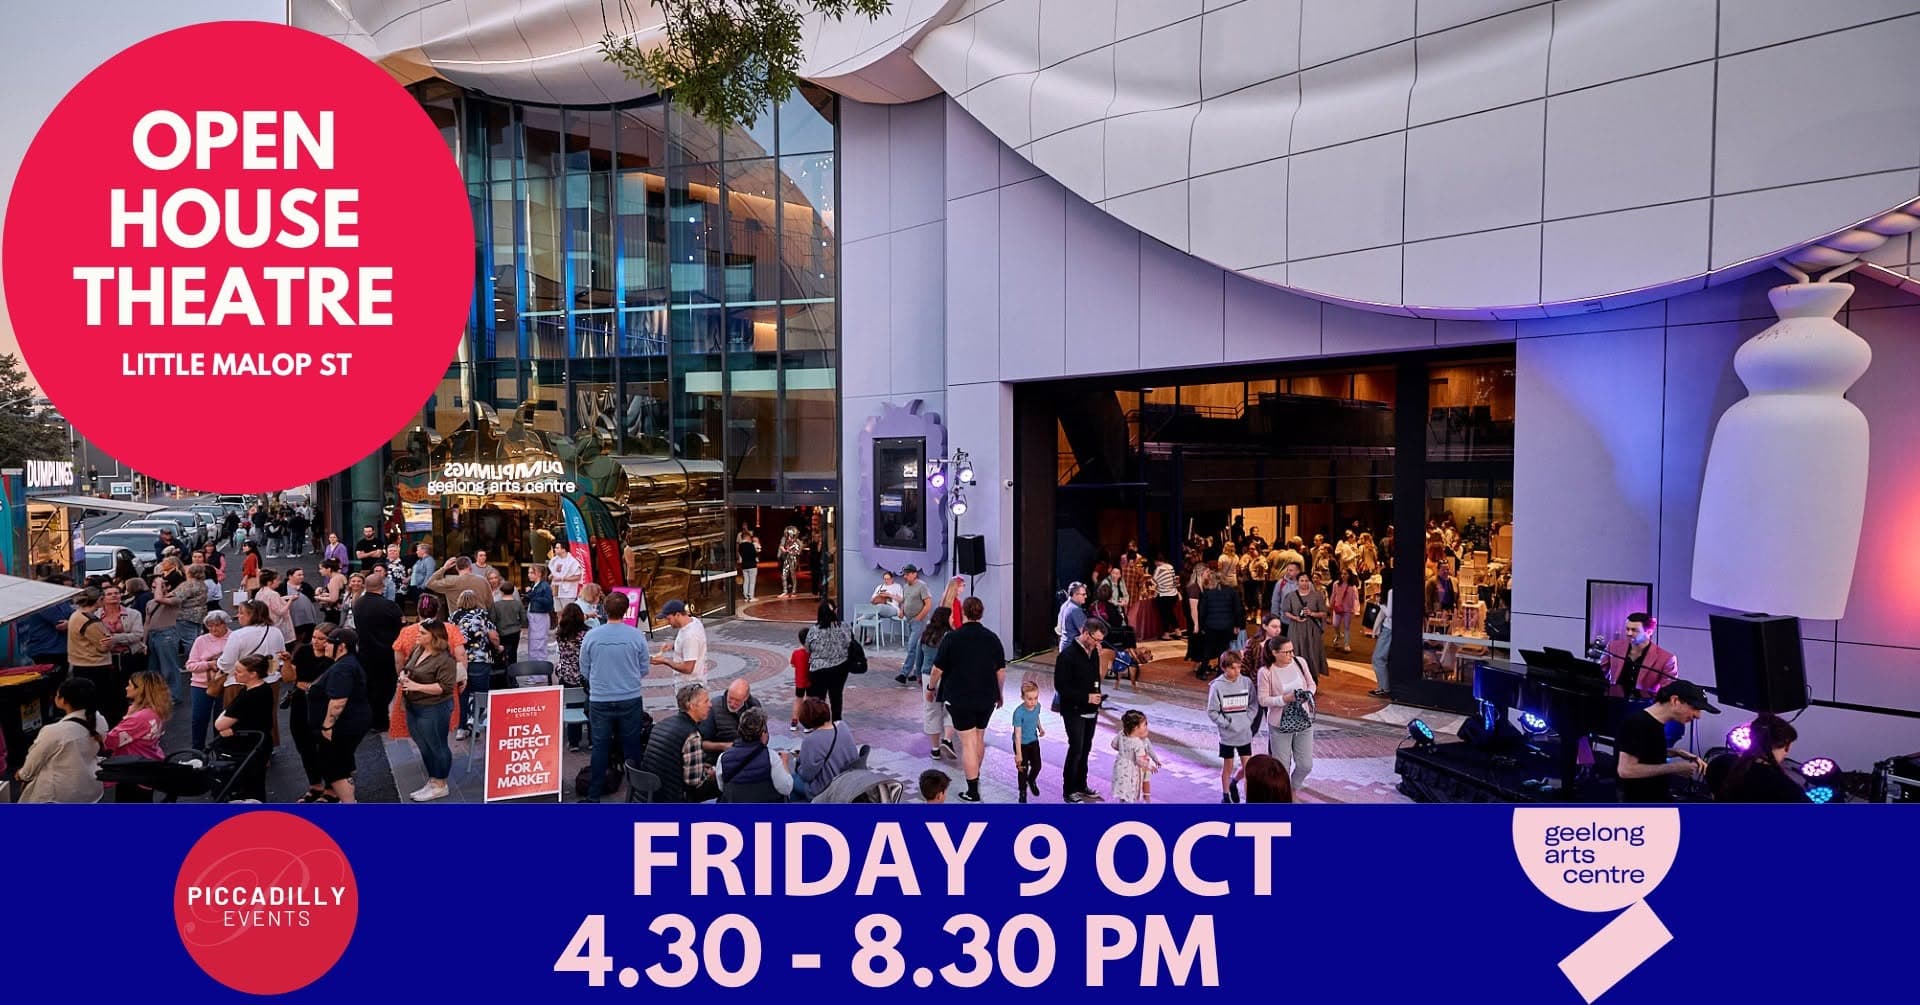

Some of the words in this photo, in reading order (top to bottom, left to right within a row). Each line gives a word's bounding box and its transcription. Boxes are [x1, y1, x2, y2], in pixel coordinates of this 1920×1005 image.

[27, 460, 74, 487] DUMPLINGS
[428, 479, 485, 495] geelong
[489, 480, 520, 493] arts
[525, 480, 576, 493] centre
[506, 705, 546, 714] PICCADILLY
[508, 724, 530, 737] IT'S
[532, 724, 542, 735] A
[498, 735, 551, 750] PERFECT
[511, 748, 539, 762] DAY
[505, 762, 531, 775] FOR
[533, 760, 544, 772] A
[497, 772, 551, 789] MARKET
